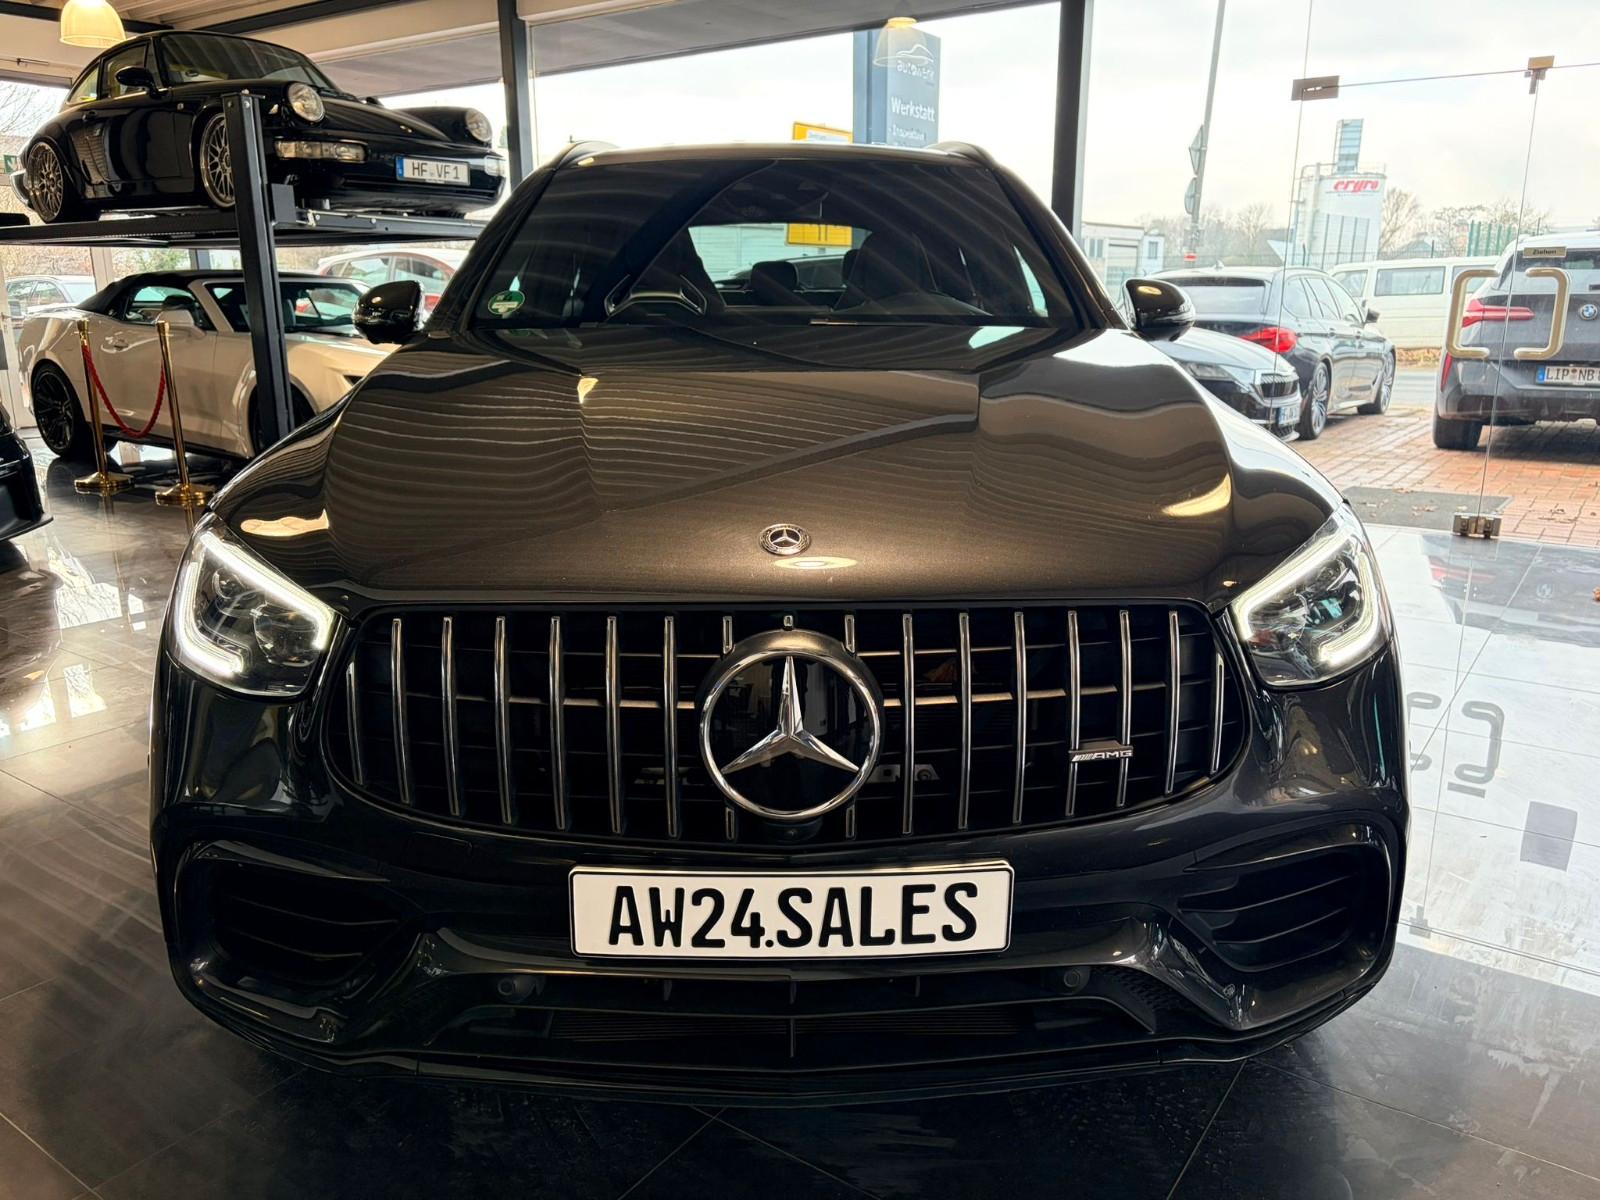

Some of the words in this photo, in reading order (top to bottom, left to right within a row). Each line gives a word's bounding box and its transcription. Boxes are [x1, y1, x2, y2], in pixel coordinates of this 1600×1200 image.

[891, 96, 935, 121] Werkstatt
[412, 162, 428, 177] HF
[436, 164, 460, 179] VF1
[1546, 367, 1570, 380] LIP
[608, 882, 978, 948] AW24.SALES
